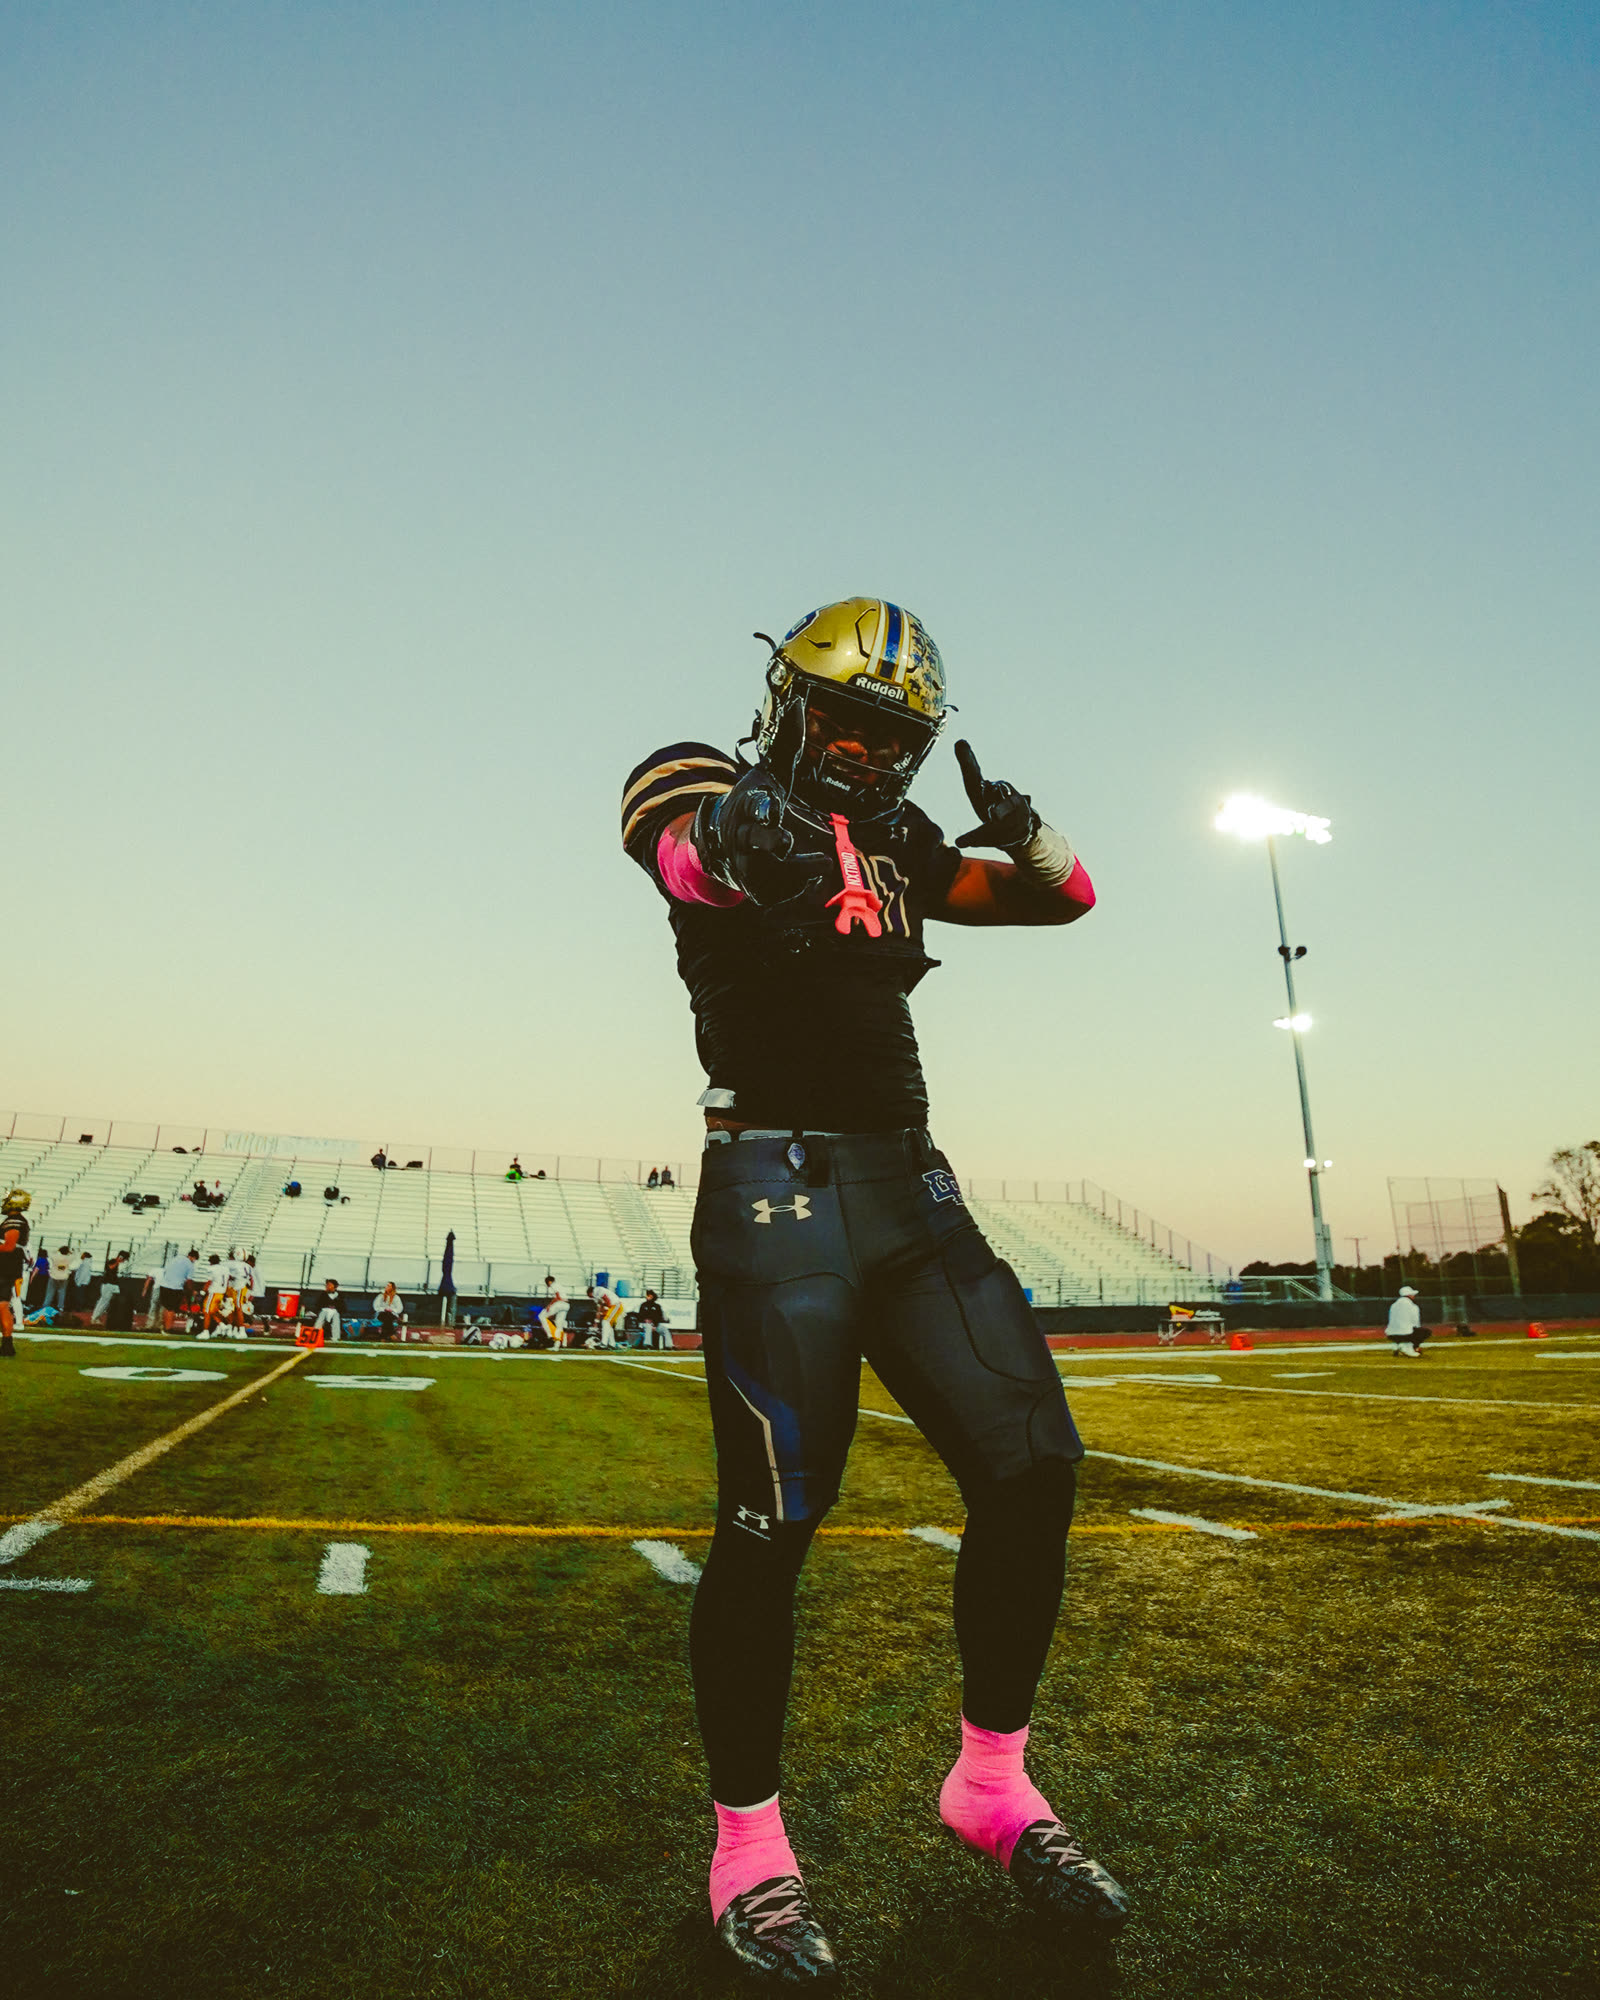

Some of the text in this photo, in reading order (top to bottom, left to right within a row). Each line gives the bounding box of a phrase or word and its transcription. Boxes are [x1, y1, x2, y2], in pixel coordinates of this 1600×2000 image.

[855, 676, 905, 701] Riddell
[826, 776, 851, 792] Riddell
[841, 852, 862, 886] NXTRND
[300, 1328, 319, 1344] 50
